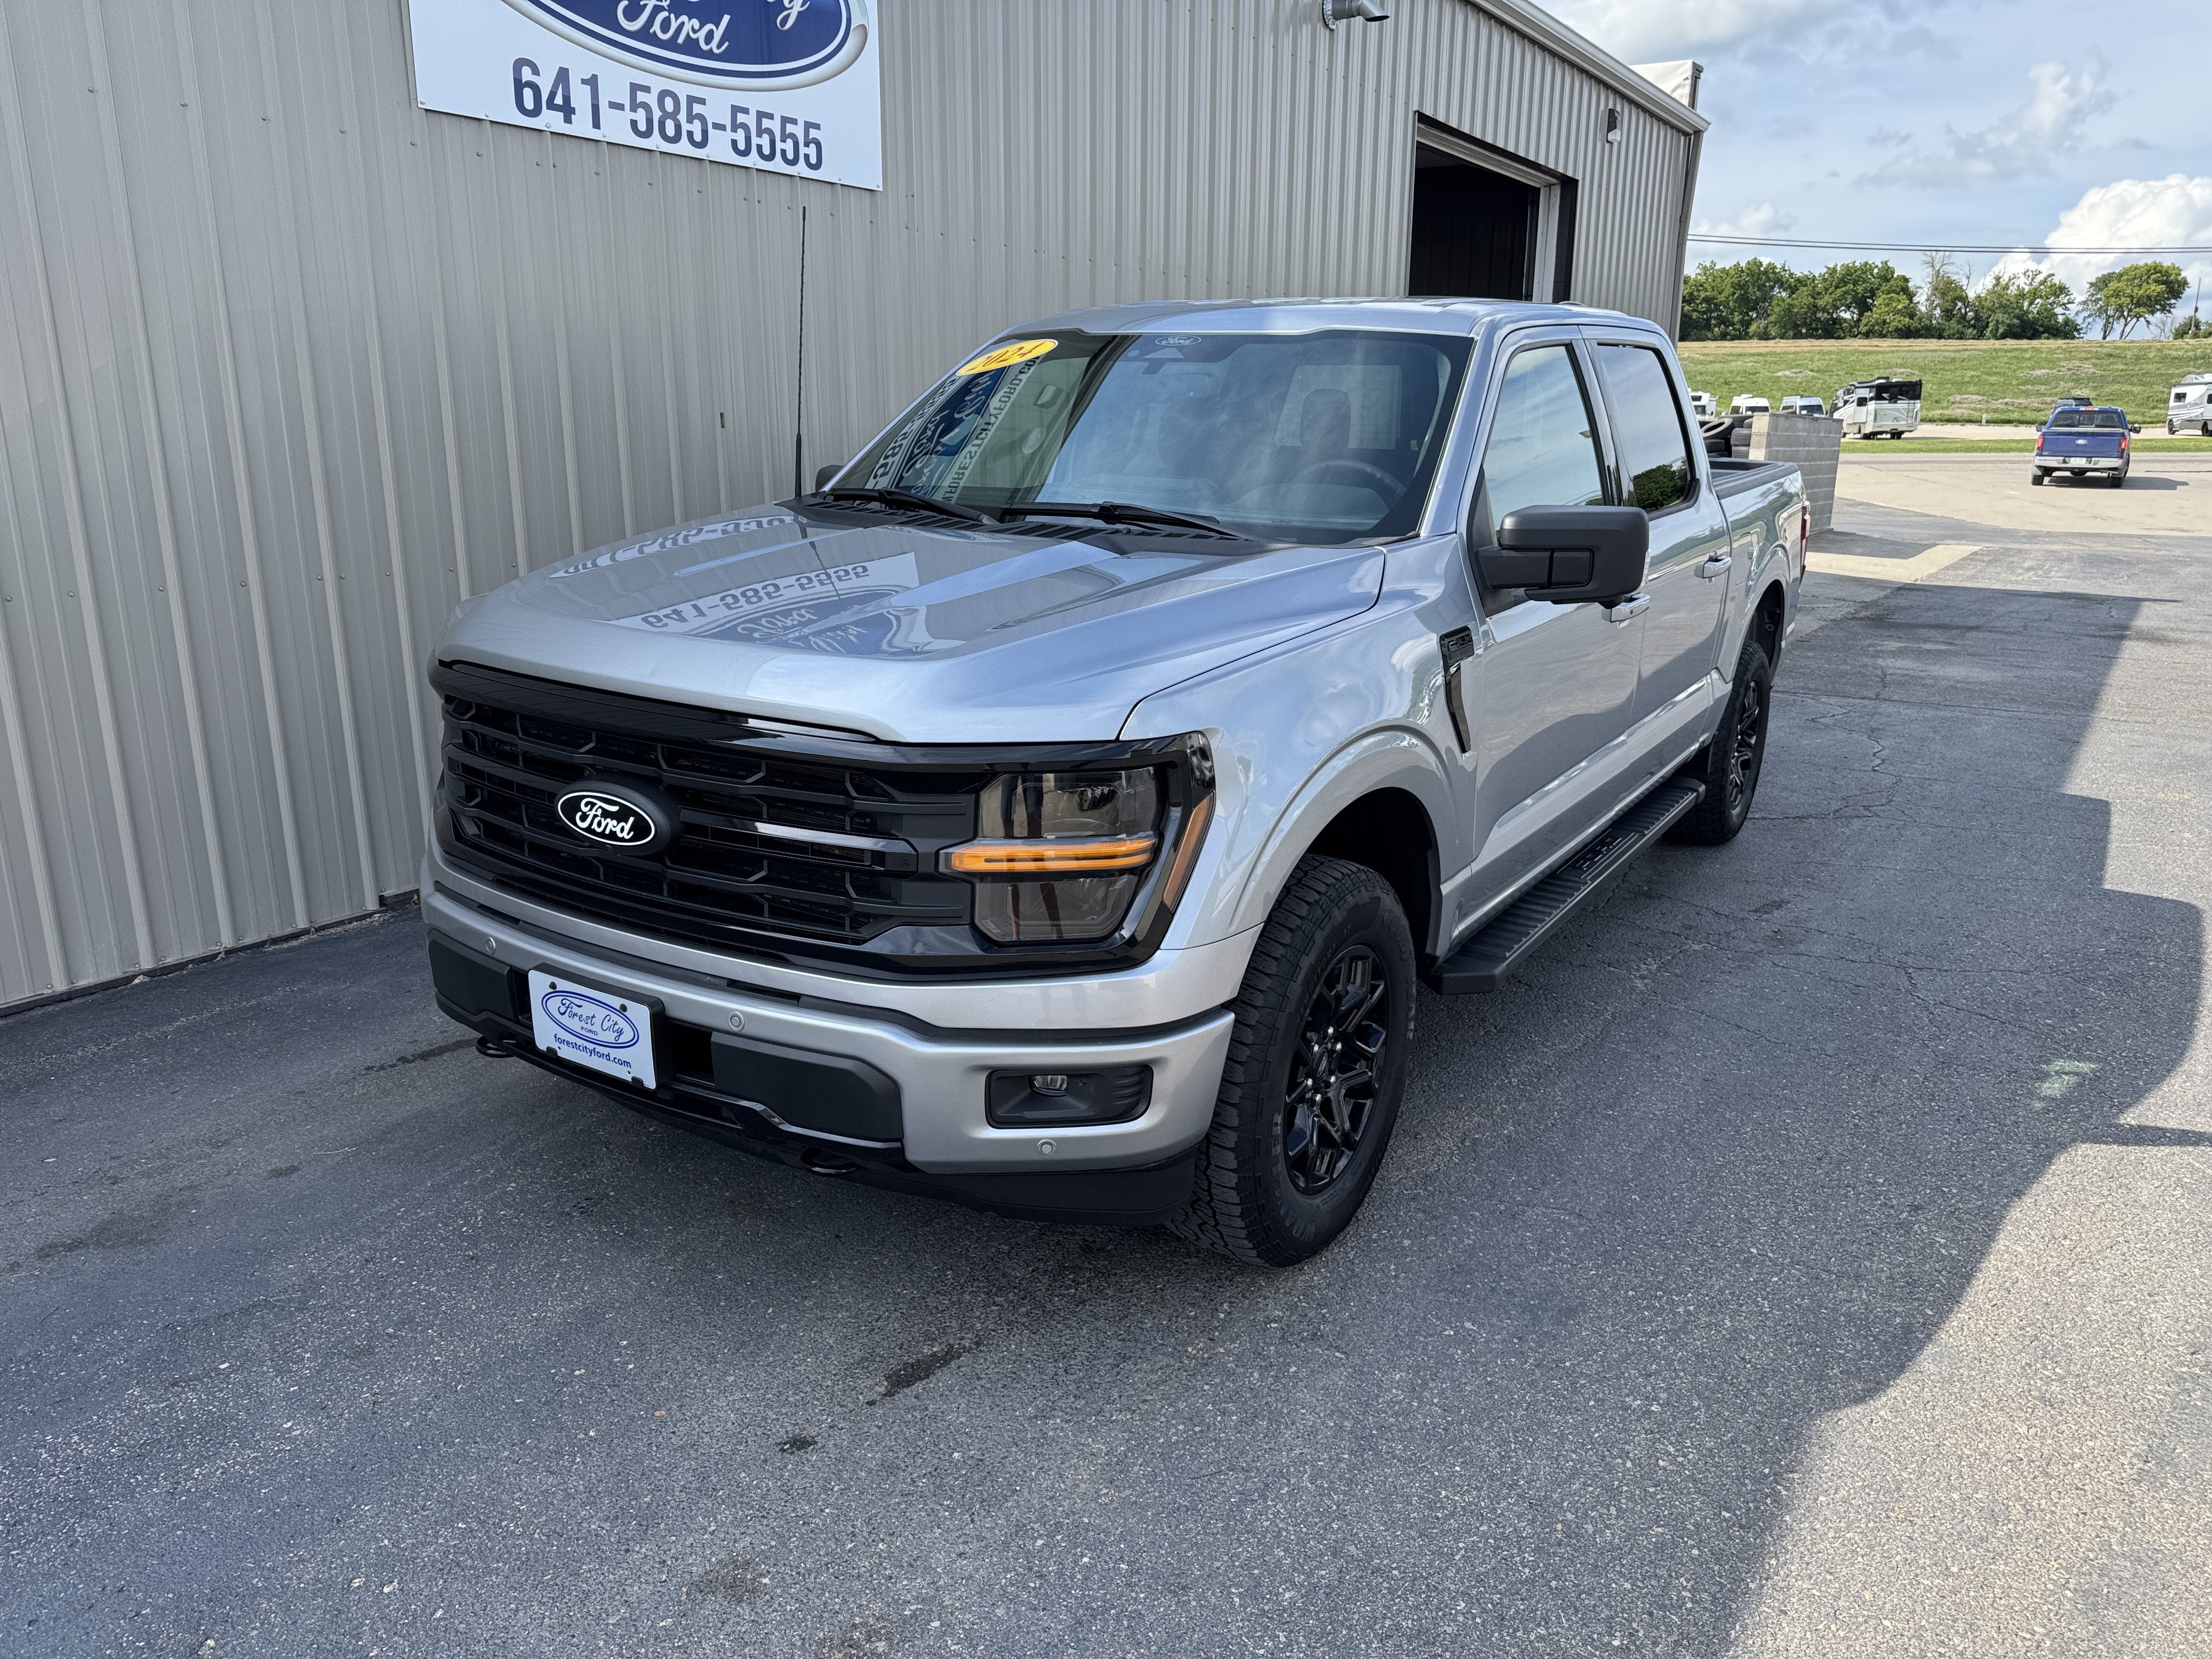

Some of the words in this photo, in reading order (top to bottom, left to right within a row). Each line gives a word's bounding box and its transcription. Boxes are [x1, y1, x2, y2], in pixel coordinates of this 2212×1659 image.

[512, 56, 823, 172] 641-585-5555
[964, 341, 1046, 373] 2024
[575, 797, 635, 840] Ford
[557, 997, 596, 1026] Forest
[601, 1014, 624, 1042] City
[580, 1025, 599, 1036] FORD
[553, 1033, 632, 1069] forestcityford.com
